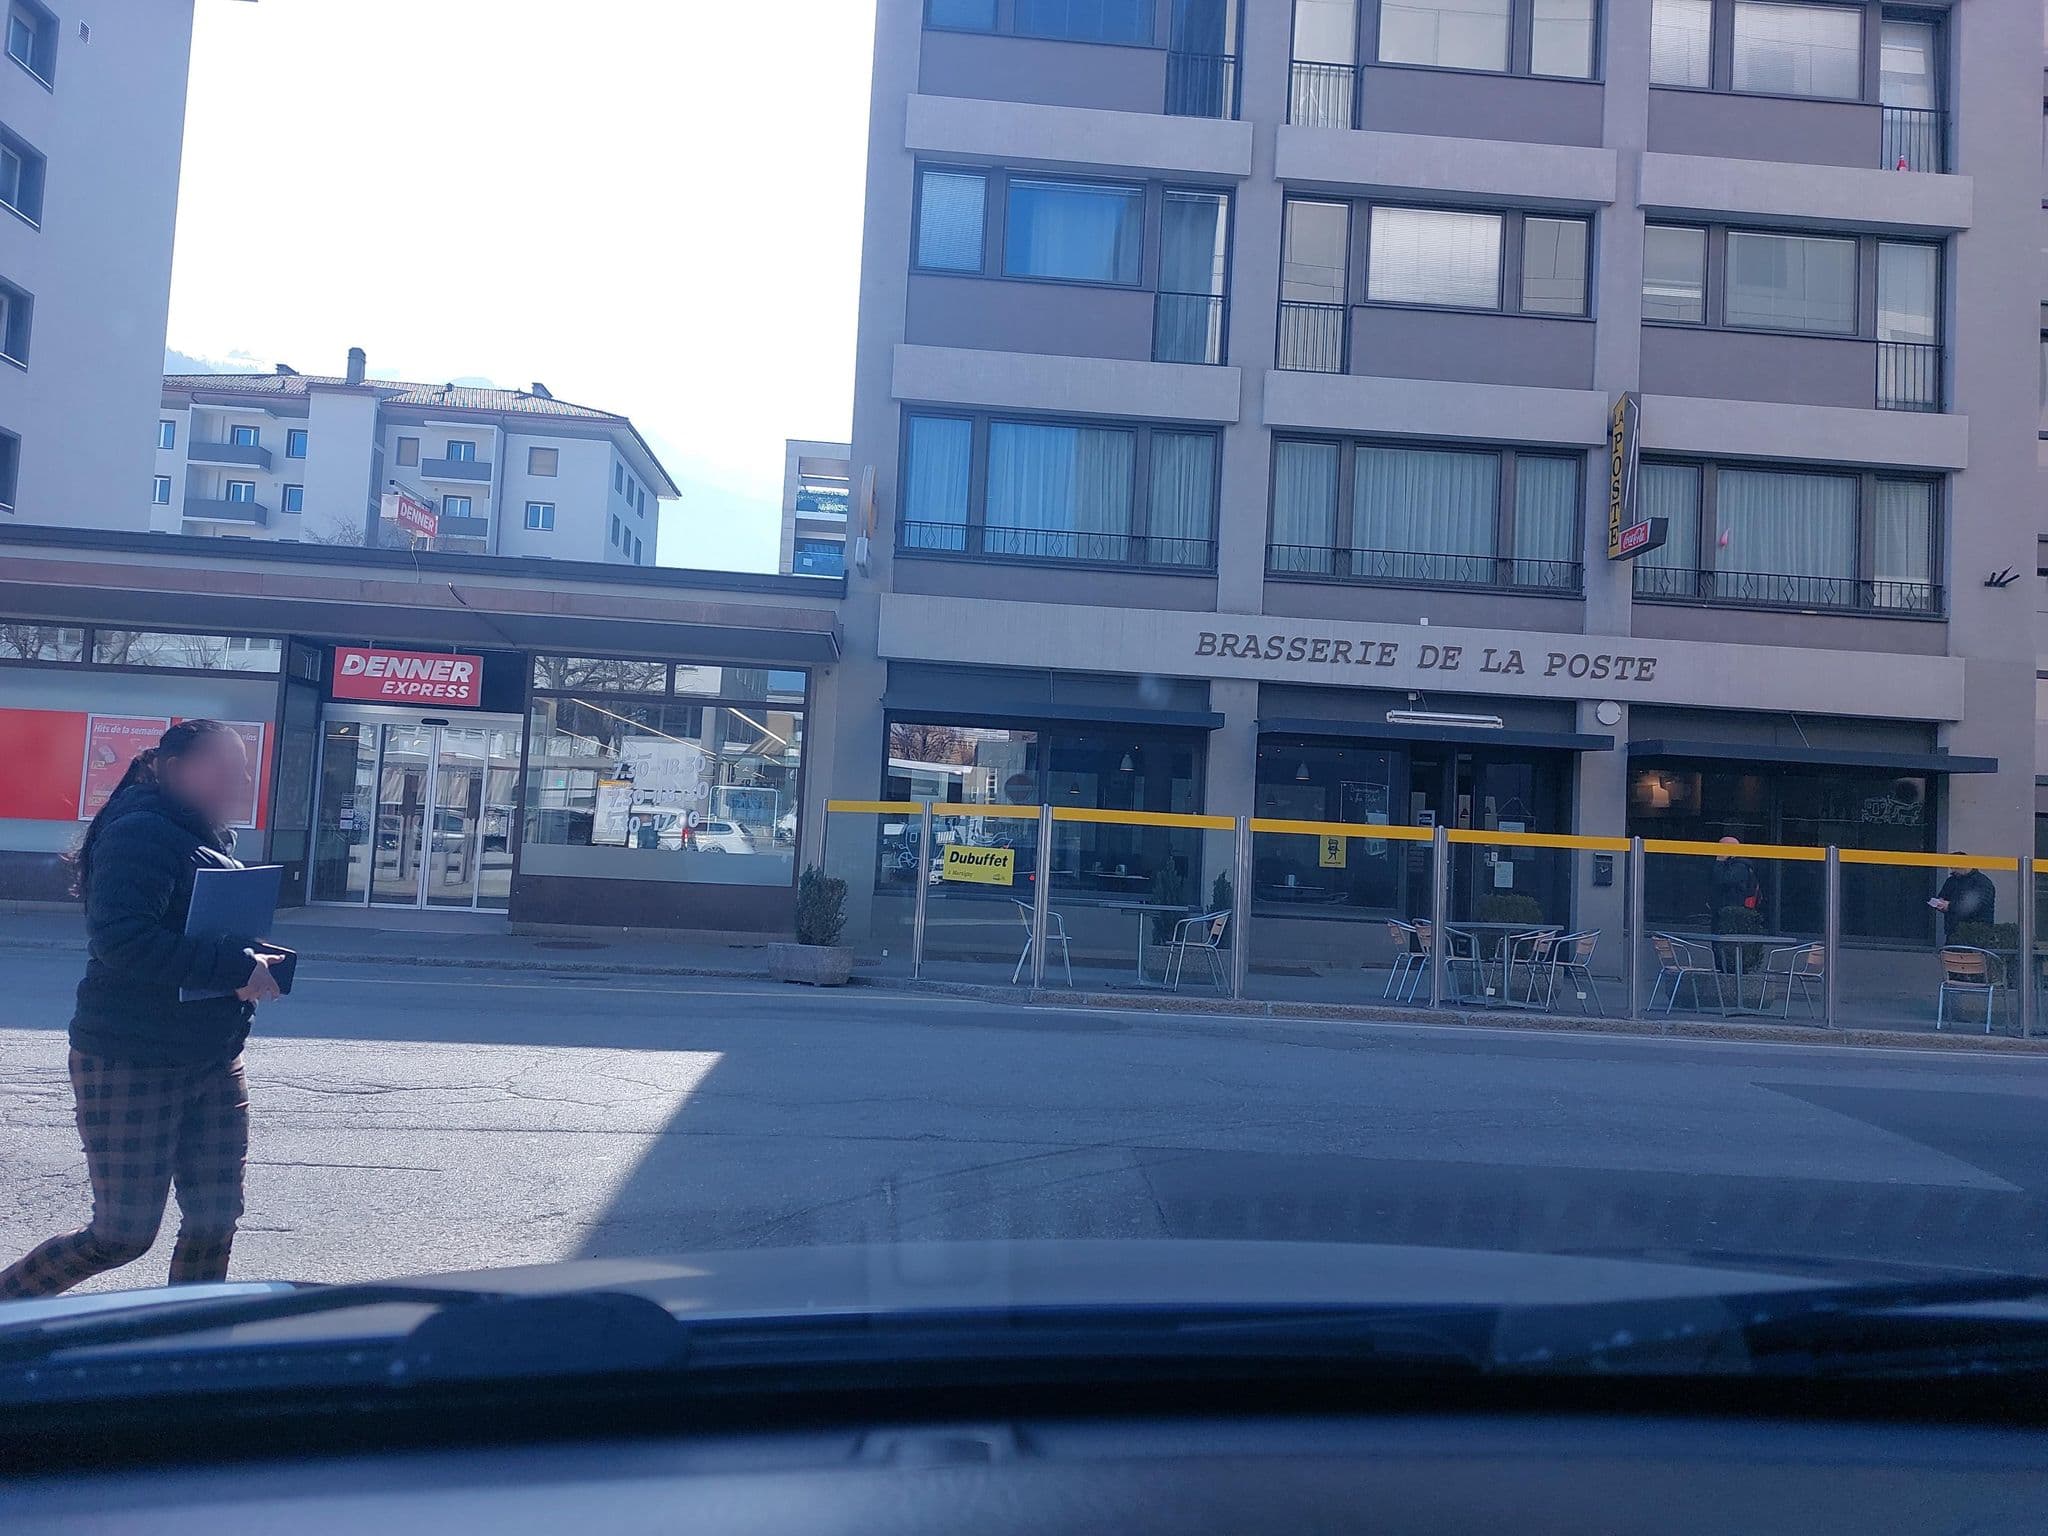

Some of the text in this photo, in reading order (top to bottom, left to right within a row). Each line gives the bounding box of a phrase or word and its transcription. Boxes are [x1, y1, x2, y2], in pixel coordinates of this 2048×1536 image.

[1610, 410, 1624, 547] LA POSTE
[400, 502, 435, 532] DENNER
[341, 654, 474, 683] DENNER
[1195, 632, 1657, 682] BRASSERIE DE LA POSTE
[382, 681, 470, 699] EXPRESS
[93, 723, 111, 733] Hits
[111, 724, 122, 734] de
[122, 726, 131, 735] la
[949, 851, 1009, 867] Dubuffet
